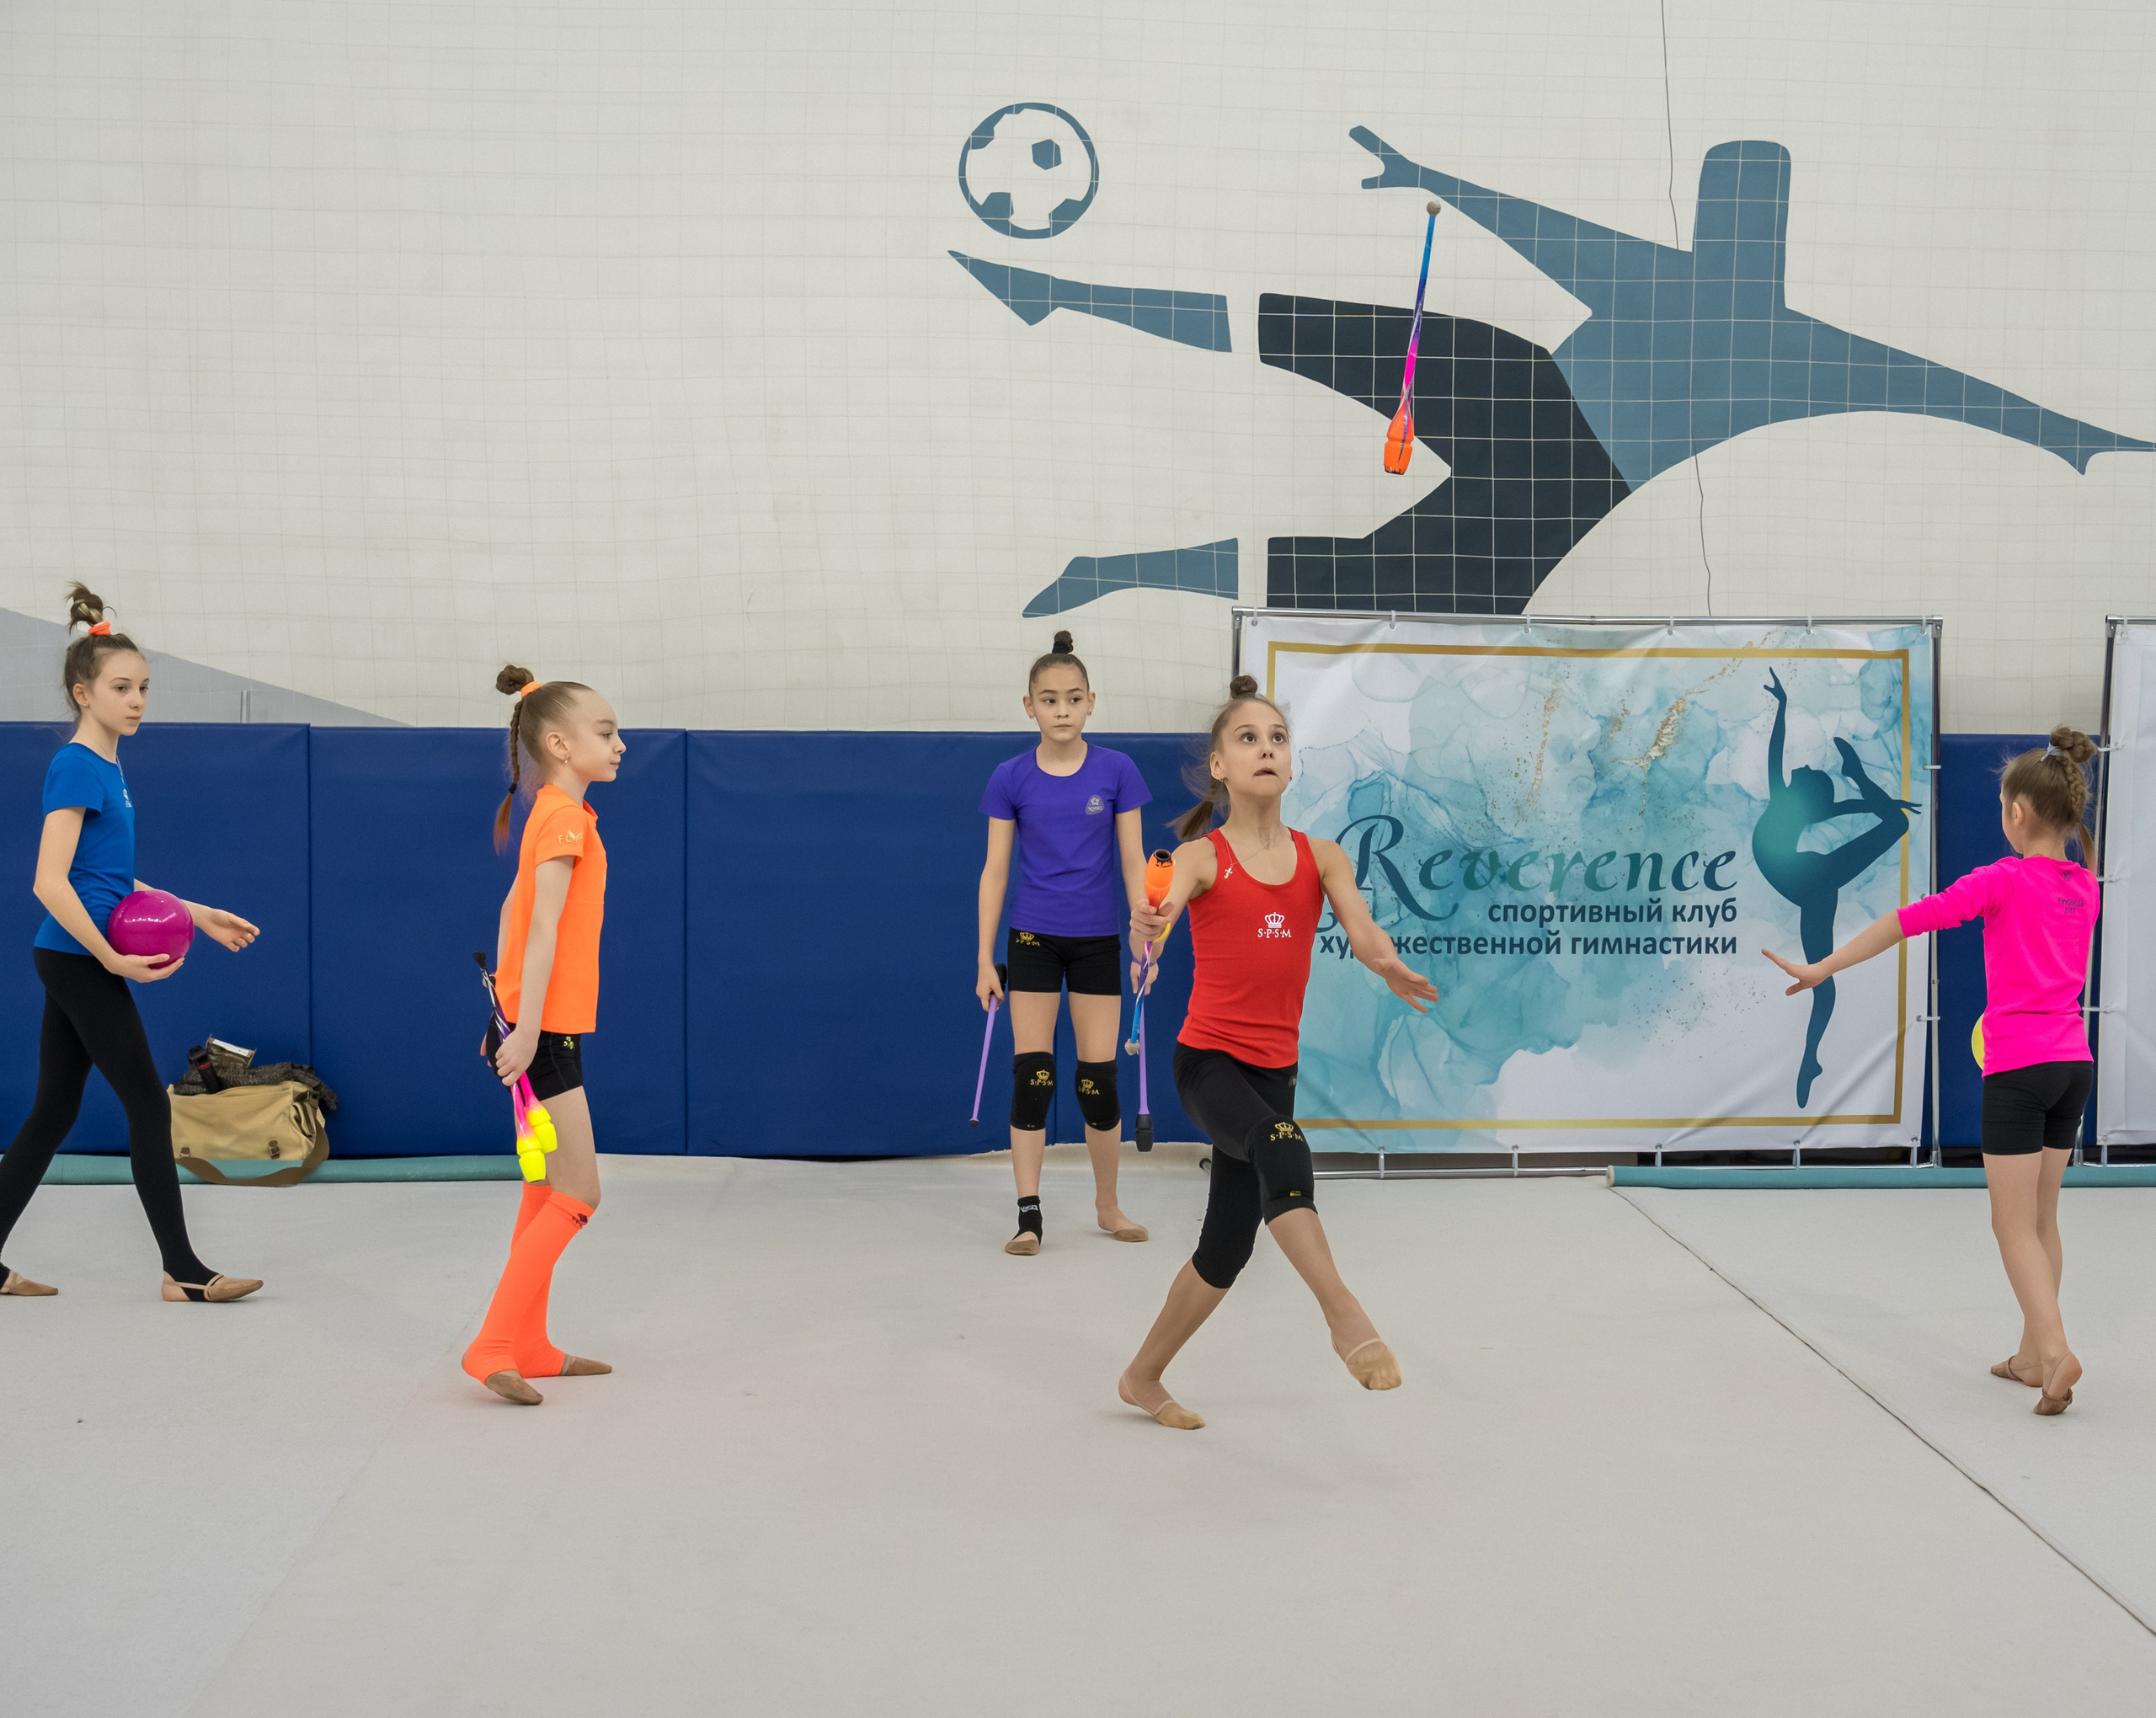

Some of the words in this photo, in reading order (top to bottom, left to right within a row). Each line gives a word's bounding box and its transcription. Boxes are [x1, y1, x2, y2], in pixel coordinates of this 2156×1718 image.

[1315, 814, 1737, 932] Reverence
[1487, 897, 1662, 928] спортивный
[1673, 897, 1737, 928] клуб
[1320, 929, 1561, 960] хужественной
[1571, 936, 1737, 955] гимнастики
